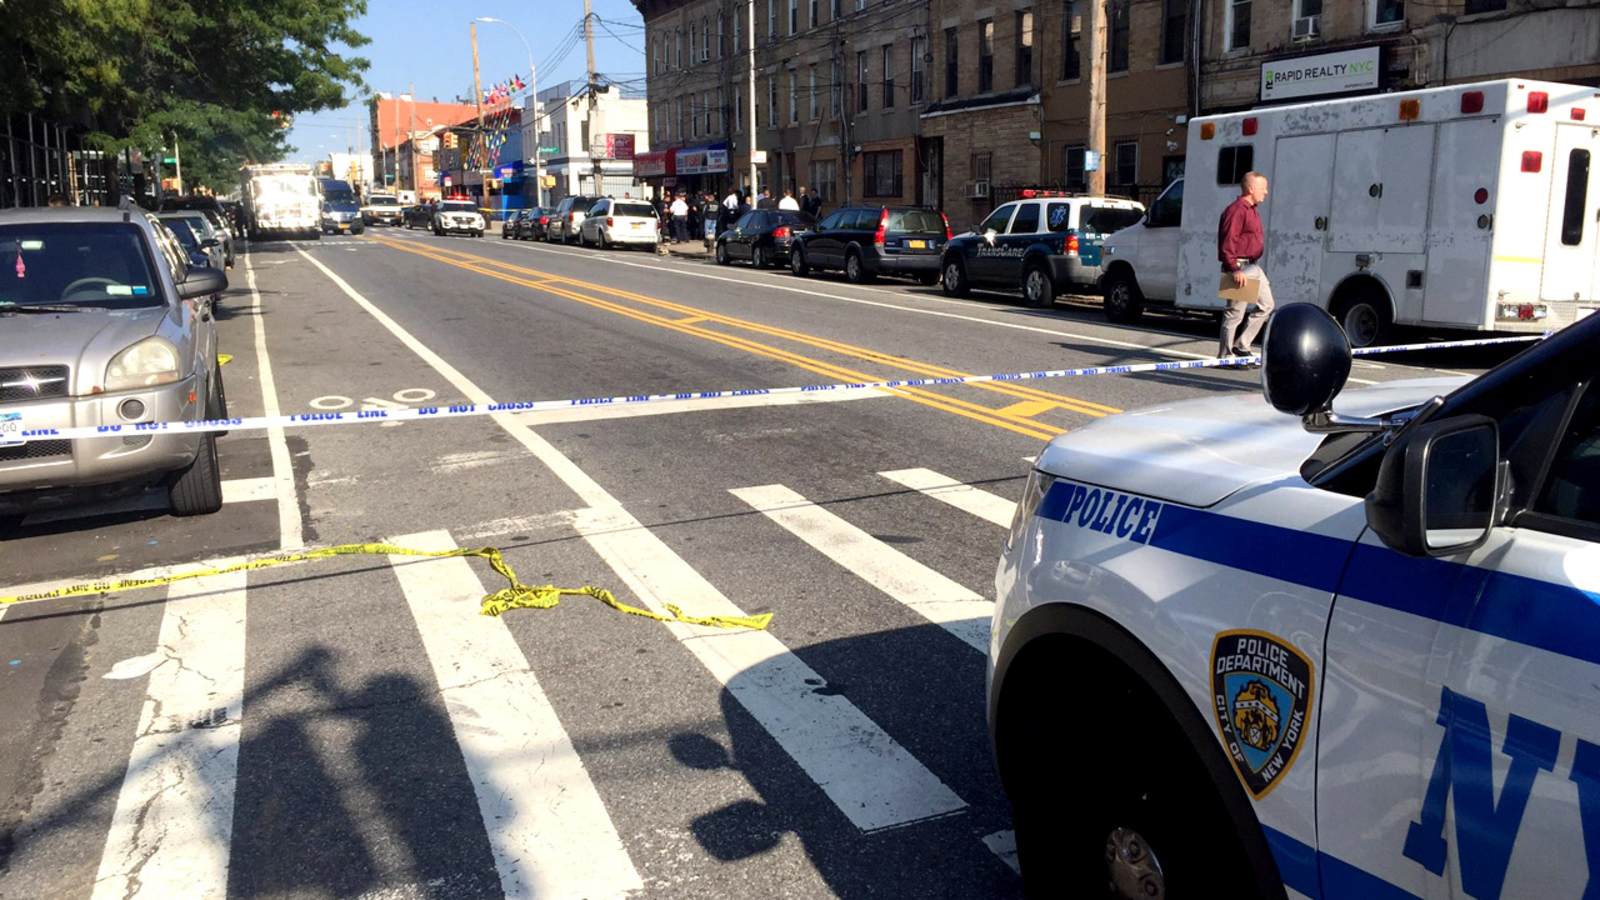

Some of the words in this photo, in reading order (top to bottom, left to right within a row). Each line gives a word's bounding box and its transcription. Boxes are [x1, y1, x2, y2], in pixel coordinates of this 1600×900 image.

[1275, 70, 1302, 83] RAPID
[1305, 64, 1347, 79] REALTY
[1350, 60, 1374, 73] NYC
[1063, 485, 1162, 545] POLICE
[1216, 654, 1305, 699] DEPARTMENT
[1237, 638, 1289, 668] POLICE
[1216, 694, 1232, 733] CITY
[1229, 742, 1245, 762] OF
[1261, 754, 1284, 783] NEW
[1282, 709, 1304, 750] YORK
